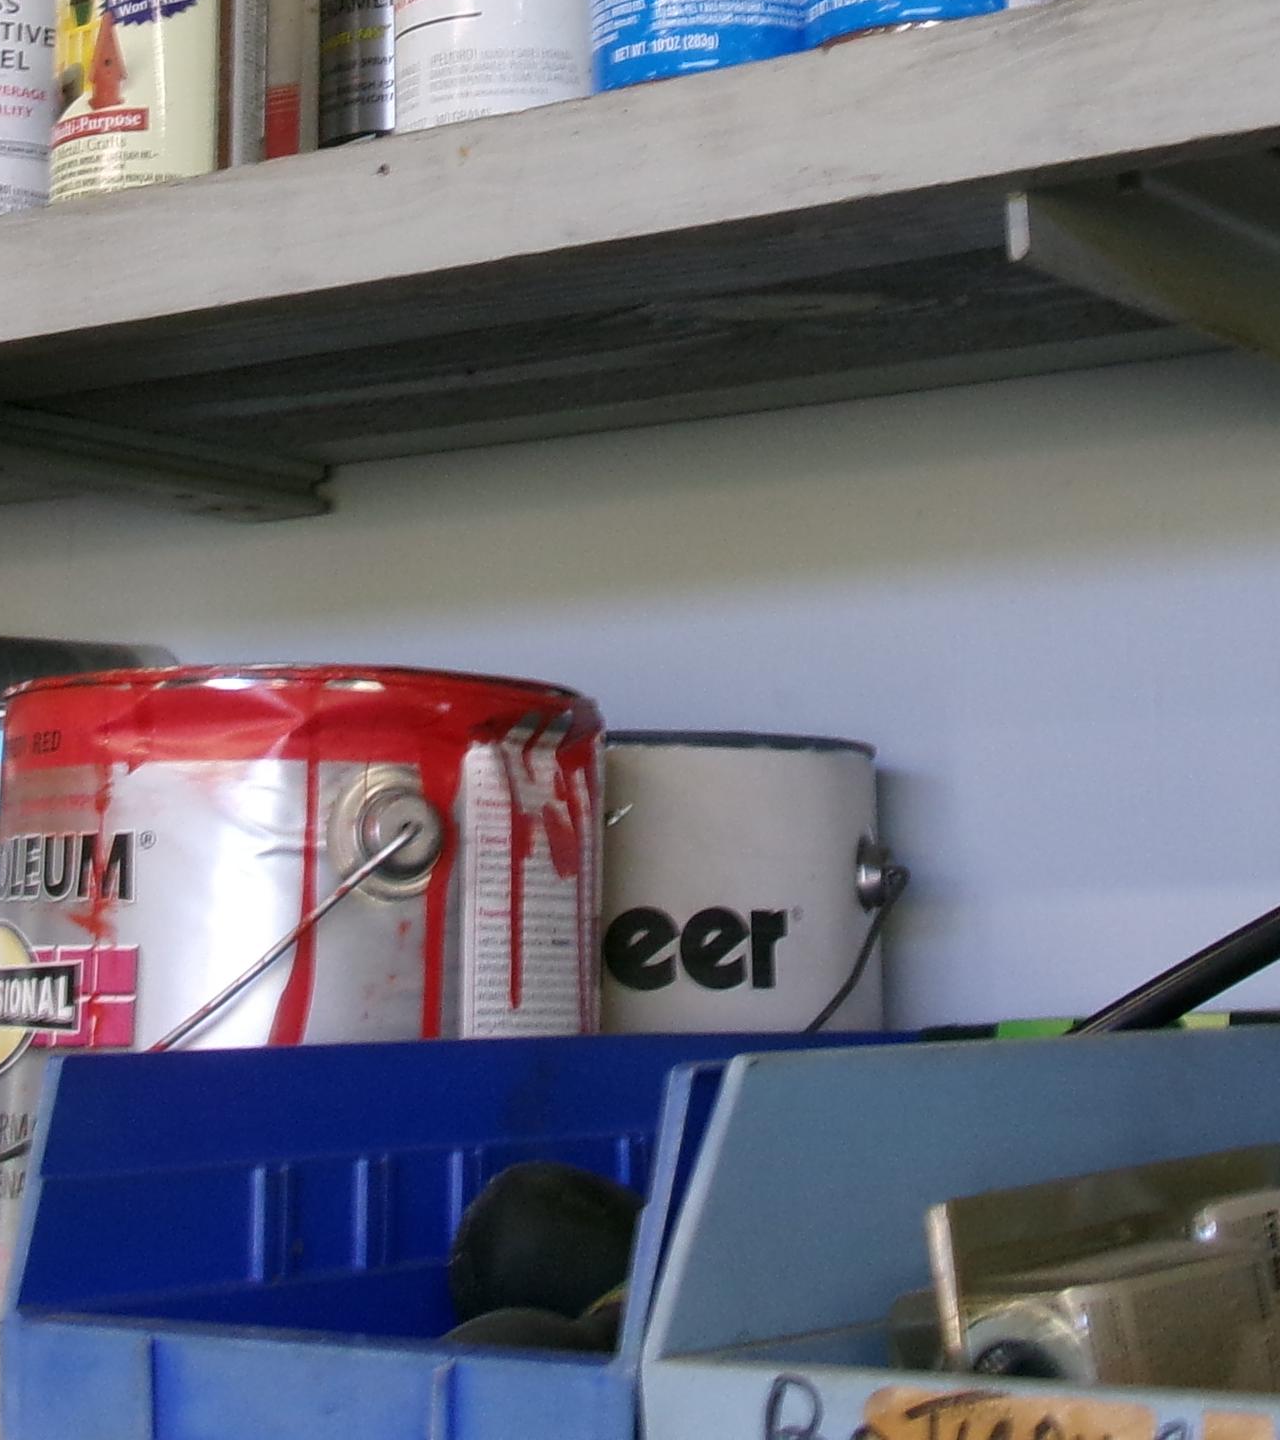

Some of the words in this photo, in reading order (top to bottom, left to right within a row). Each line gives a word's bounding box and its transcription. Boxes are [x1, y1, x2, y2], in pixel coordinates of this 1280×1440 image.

[682, 31, 720, 51] (283g)
[32, 729, 63, 756] RED
[604, 905, 789, 991] eer
